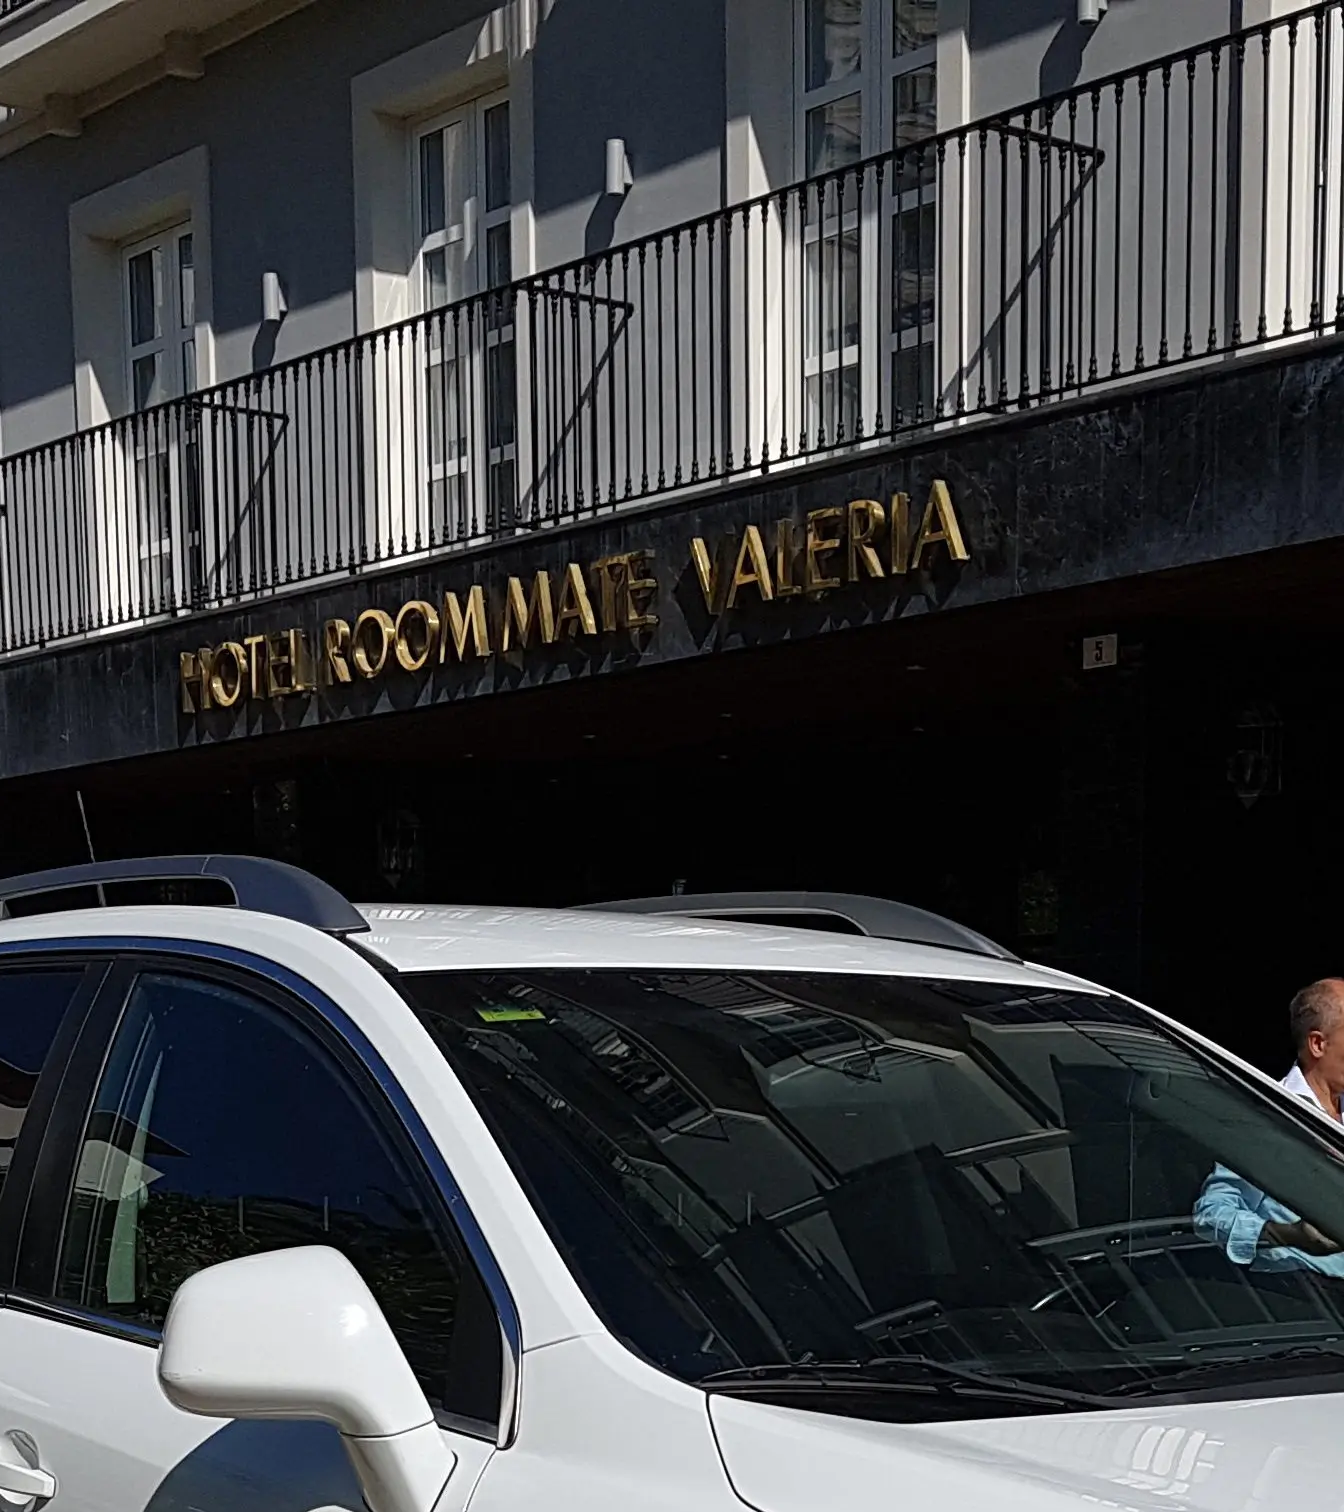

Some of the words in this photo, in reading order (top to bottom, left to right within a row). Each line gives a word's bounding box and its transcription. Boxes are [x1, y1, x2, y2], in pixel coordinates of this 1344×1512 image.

[179, 628, 316, 714] HOTEL
[324, 584, 491, 685] ROOM
[502, 549, 660, 652] MATE
[689, 479, 970, 616] VALERIA
